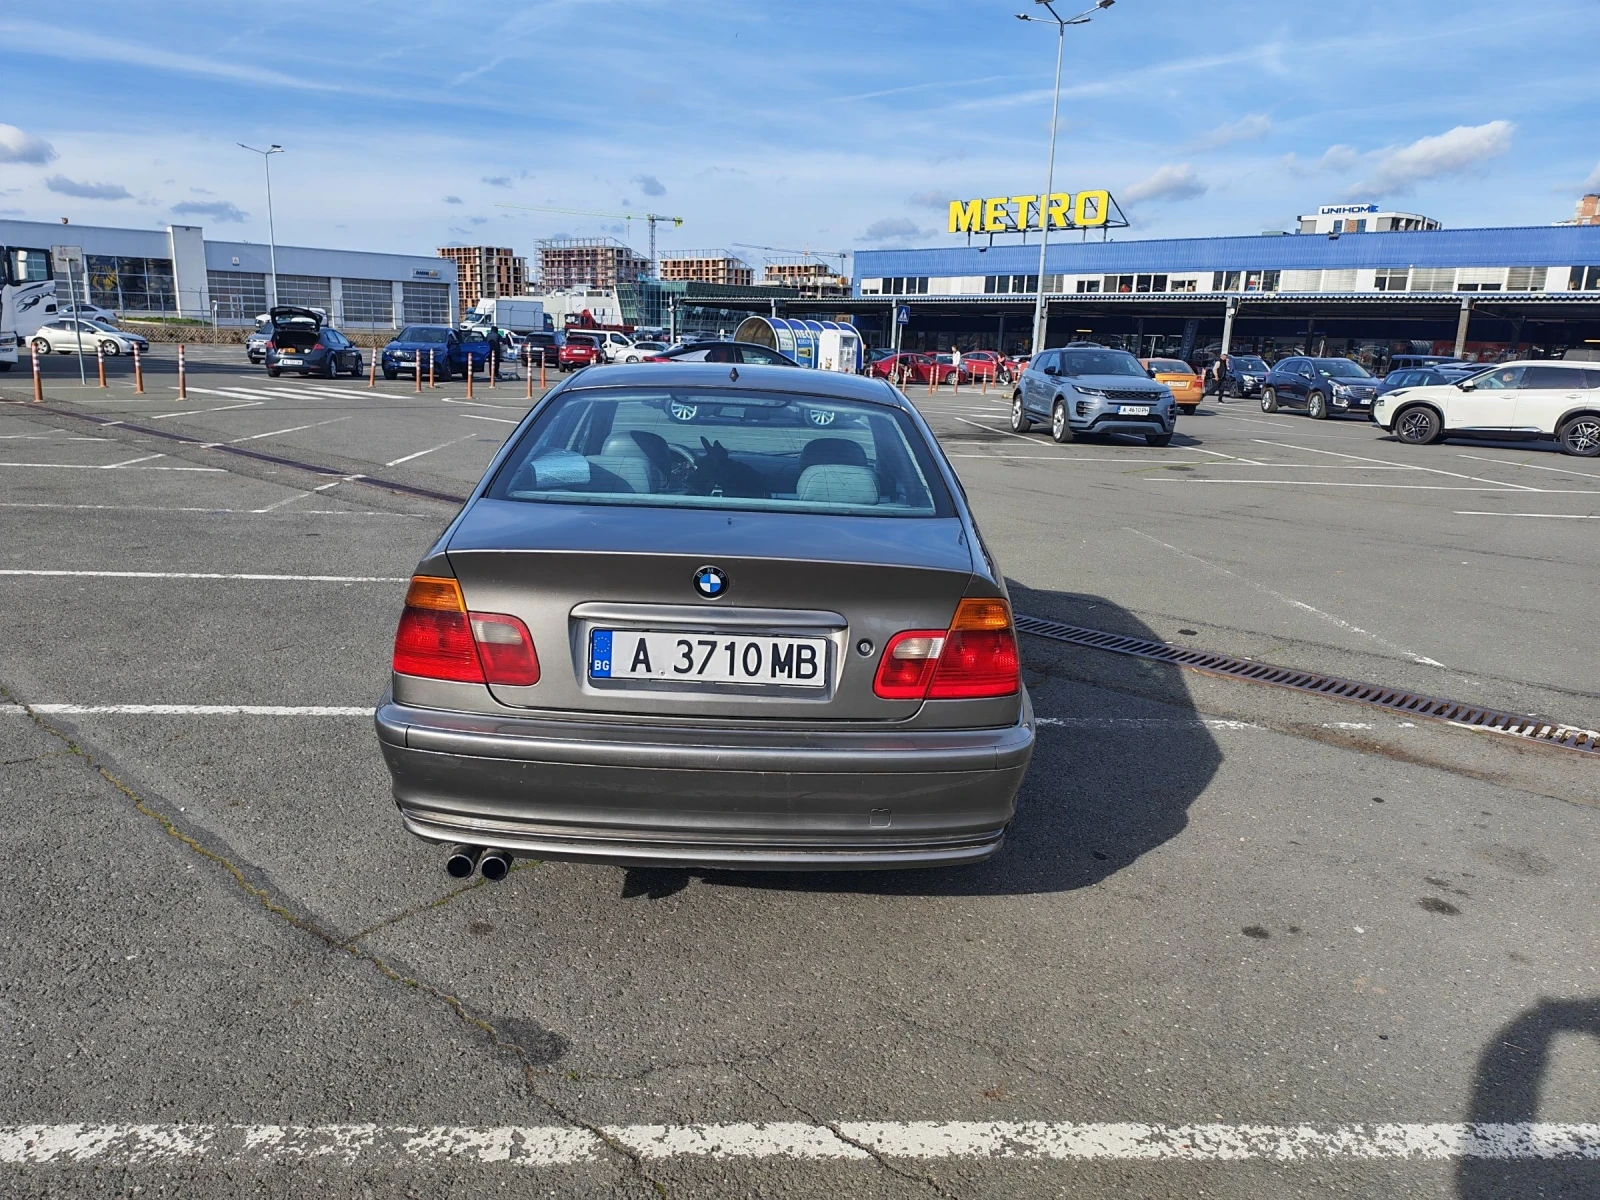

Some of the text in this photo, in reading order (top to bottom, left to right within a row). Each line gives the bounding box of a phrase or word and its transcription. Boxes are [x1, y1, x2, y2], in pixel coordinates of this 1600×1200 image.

[948, 189, 1109, 233] METRO
[696, 567, 725, 579] BMW
[594, 659, 610, 671] BG
[629, 637, 652, 673] A
